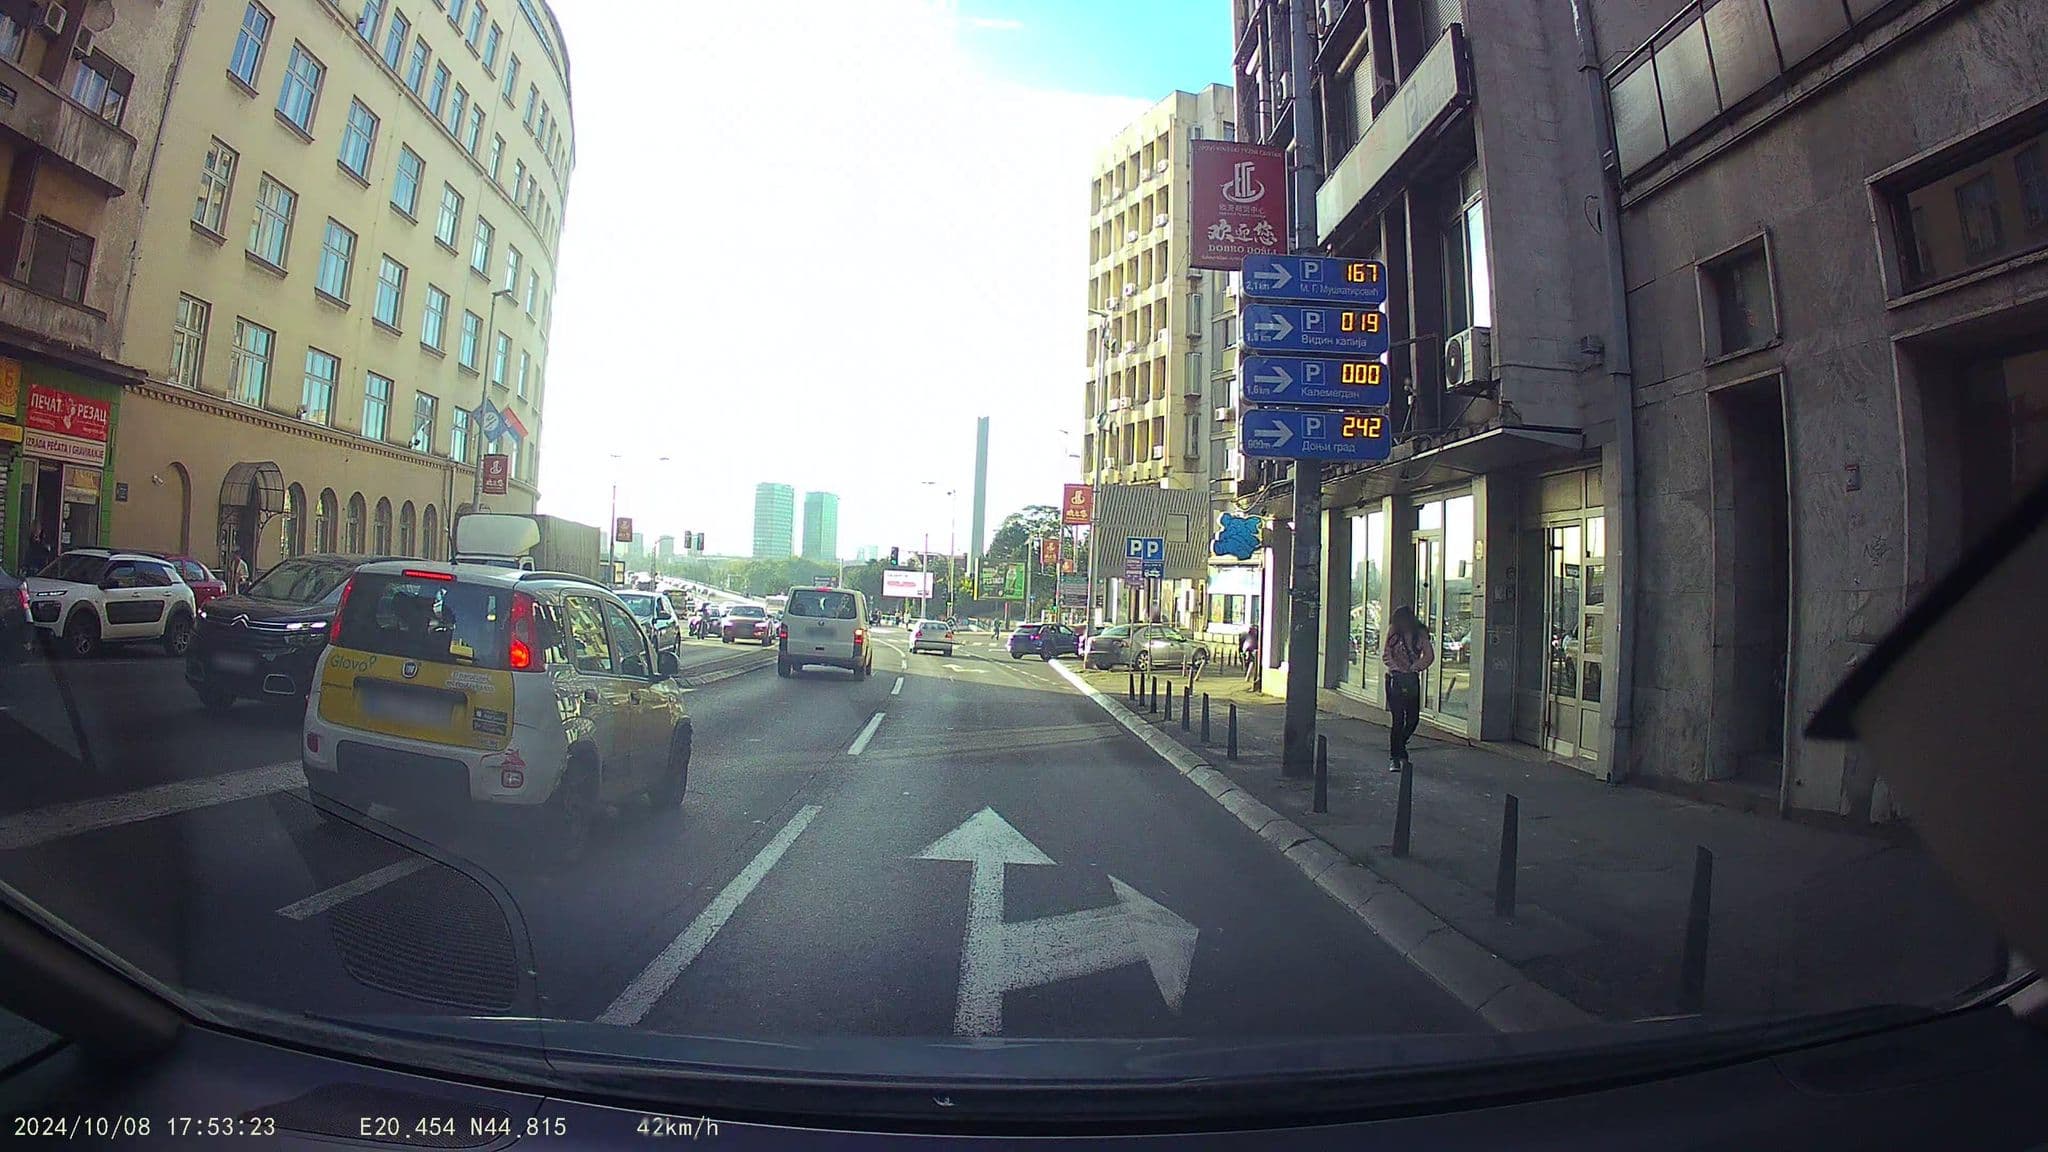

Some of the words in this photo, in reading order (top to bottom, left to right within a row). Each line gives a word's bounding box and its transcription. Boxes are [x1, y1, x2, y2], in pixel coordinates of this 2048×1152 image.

[1207, 218, 1278, 246] 欢迎您
[1208, 244, 1245, 253] DOBRO
[1304, 261, 1319, 279] P
[1347, 263, 1378, 283] 167
[1305, 312, 1321, 330] P
[1341, 311, 1379, 333] 019
[1301, 334, 1334, 345] Видин
[1335, 336, 1367, 348] капија
[1305, 364, 1321, 382] P
[1341, 363, 1380, 385] 000
[1301, 387, 1360, 399] Калемегдан
[31, 392, 62, 413] ПЕЧАТ
[77, 403, 107, 425] РЕЗАЦ
[1306, 417, 1321, 436] P
[1342, 416, 1382, 438] 242
[25, 437, 46, 450] IZRADA
[46, 439, 68, 453] PEČATA
[1301, 440, 1331, 452] Доњи
[1333, 443, 1357, 454] град
[1130, 539, 1143, 556] P
[1147, 541, 1159, 558] P
[330, 654, 370, 673] Glovo
